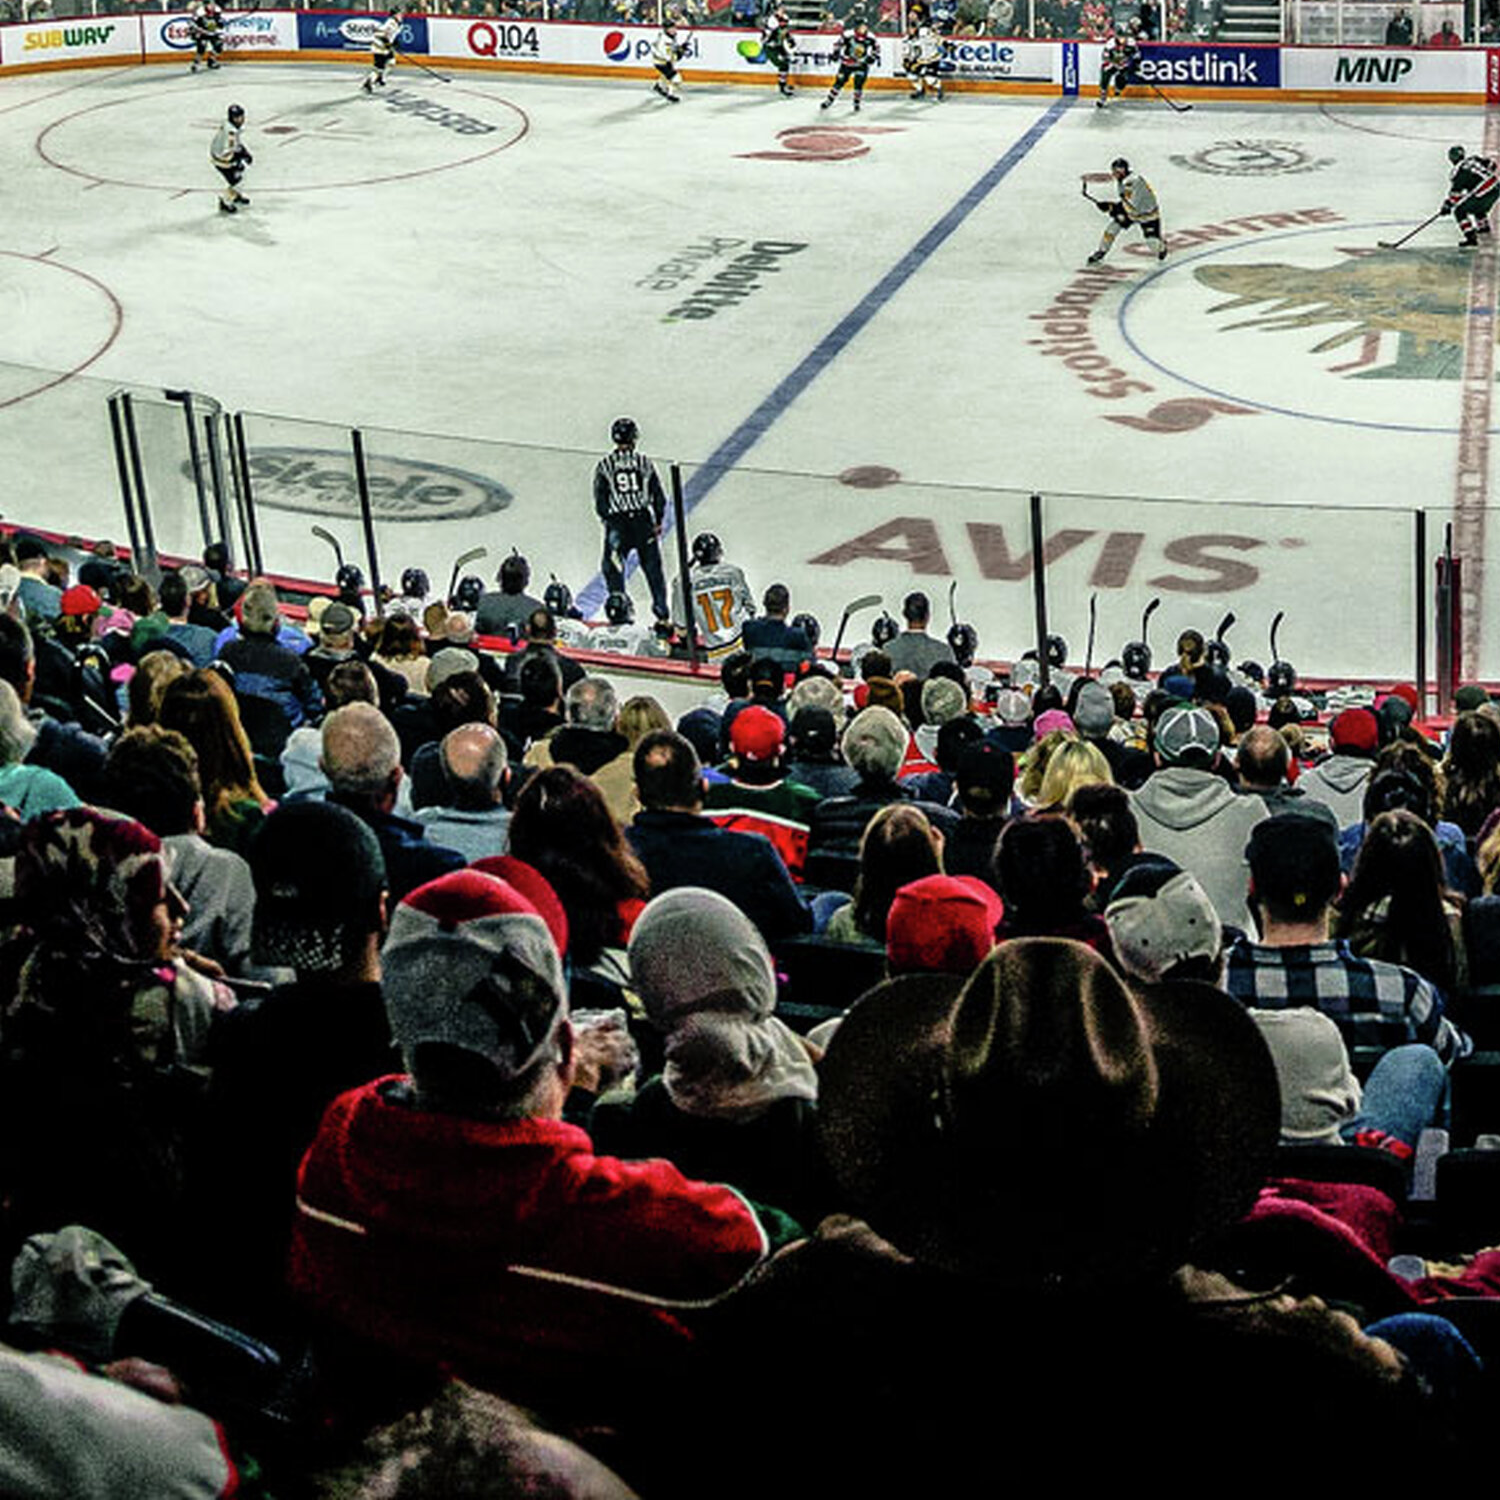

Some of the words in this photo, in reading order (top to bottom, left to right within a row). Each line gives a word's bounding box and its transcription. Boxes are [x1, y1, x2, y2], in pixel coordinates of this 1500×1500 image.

[23, 25, 117, 52] SUBWAY
[467, 21, 540, 58] Q104
[1139, 53, 1258, 83] eastlink
[1334, 57, 1413, 83] MNP
[667, 240, 809, 320] Deloitte
[248, 455, 465, 506] Steele
[615, 472, 640, 492] 91
[806, 515, 1261, 594] AVIS
[696, 587, 735, 633] 17
